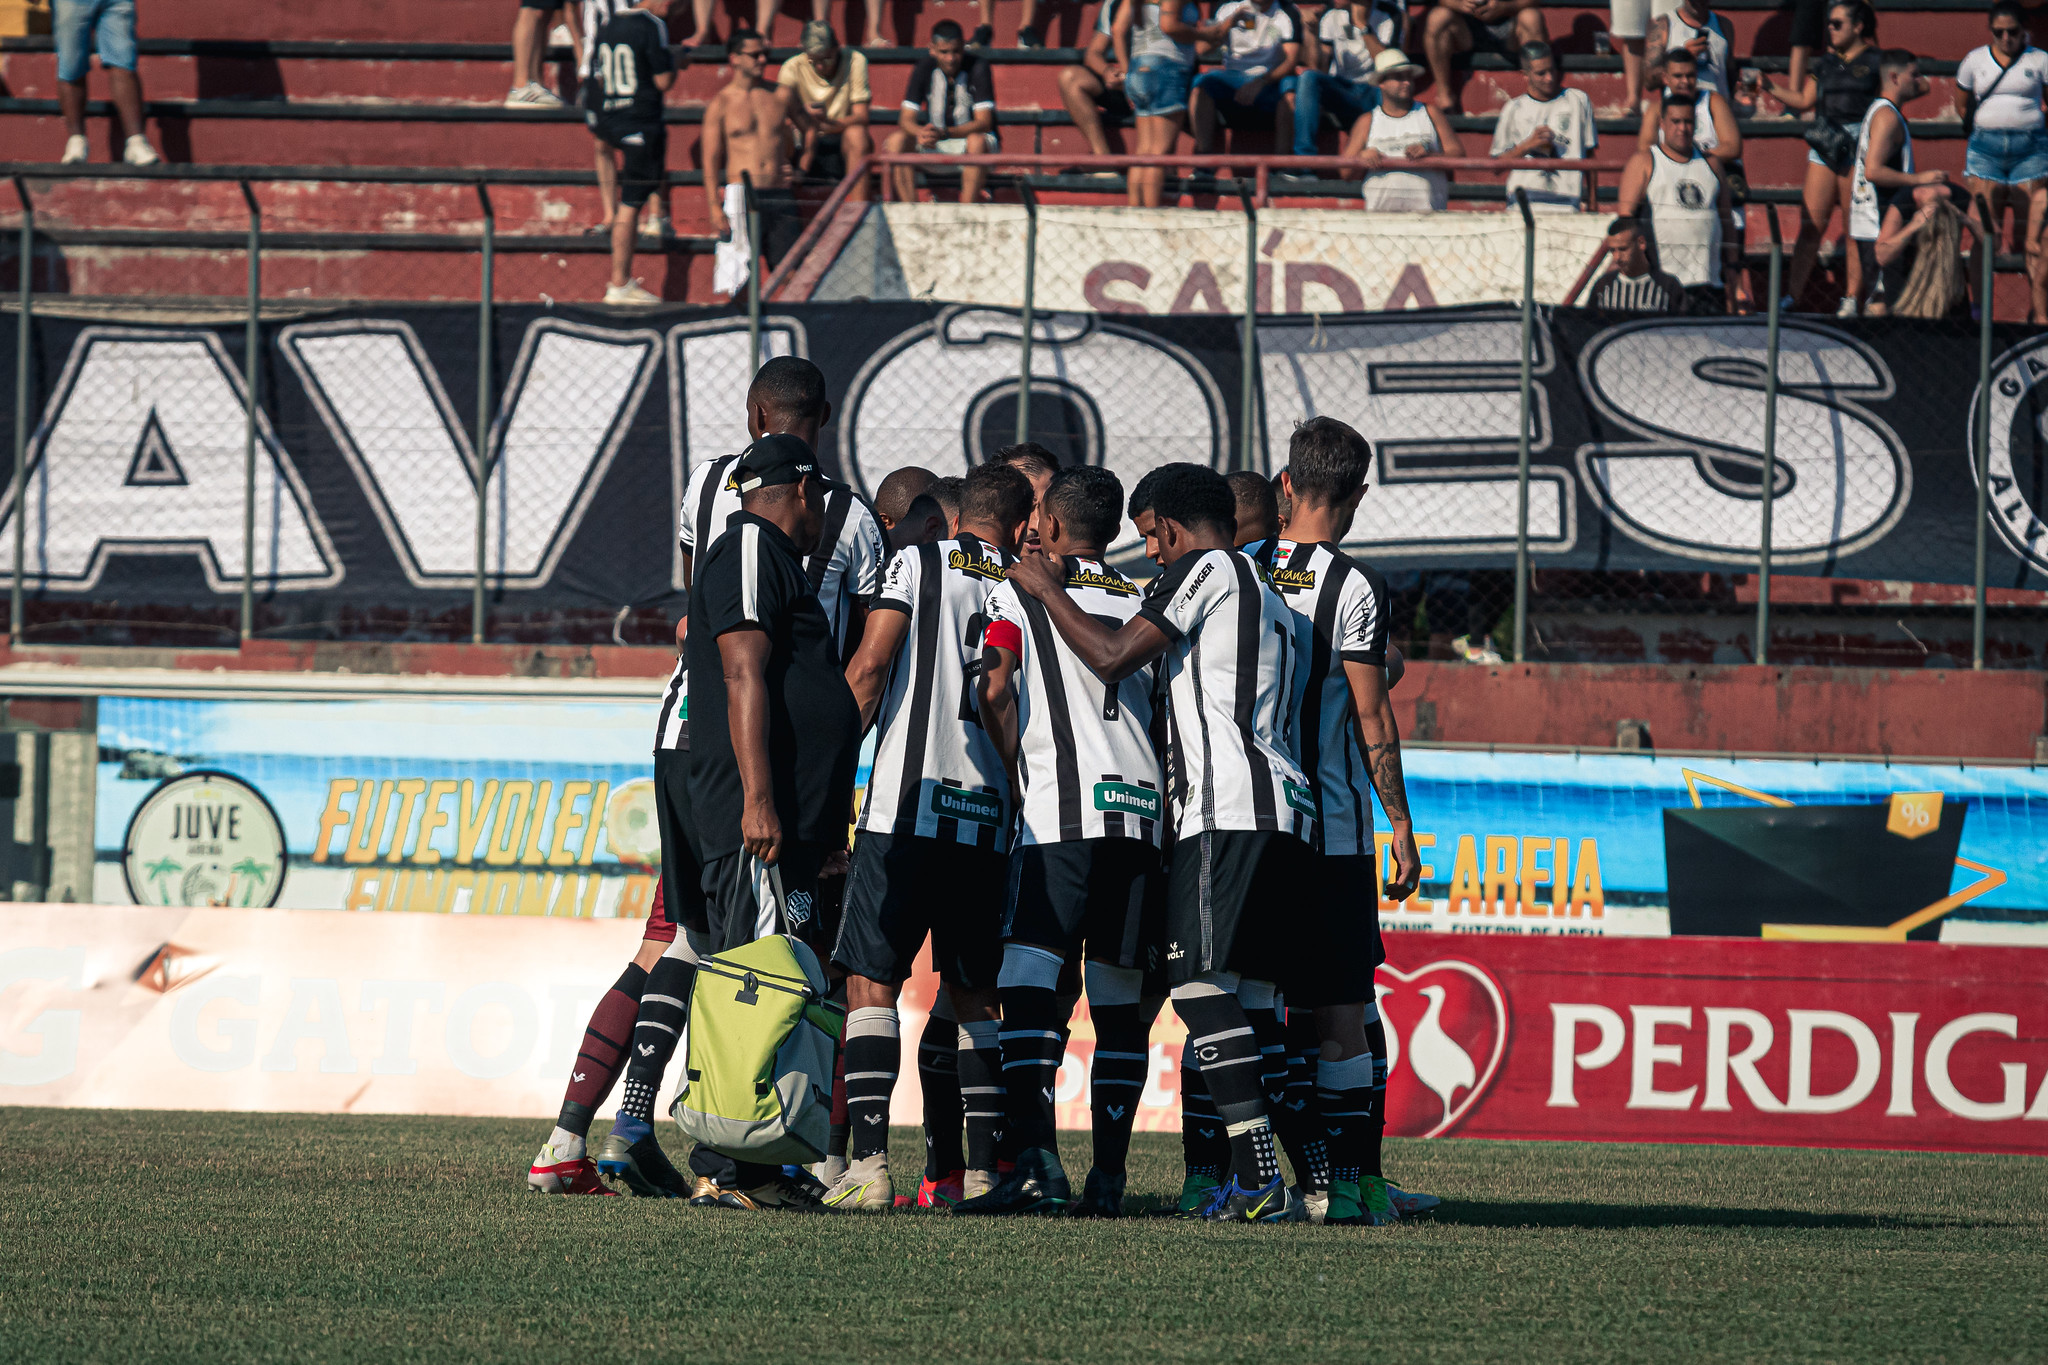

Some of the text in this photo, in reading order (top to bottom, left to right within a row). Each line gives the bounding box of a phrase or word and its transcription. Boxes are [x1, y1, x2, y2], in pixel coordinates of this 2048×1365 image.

[598, 42, 638, 95] 10
[1083, 228, 1439, 314] SAÍDA
[1185, 562, 1215, 602] LIMGER
[1273, 567, 1315, 585] erança
[941, 793, 999, 818] Unimed
[1103, 790, 1157, 812] Unimed
[1290, 788, 1316, 812] Unime
[171, 804, 242, 840] JUVE
[310, 777, 610, 867] FUTEVOLEI
[1448, 835, 1605, 919] AREIA
